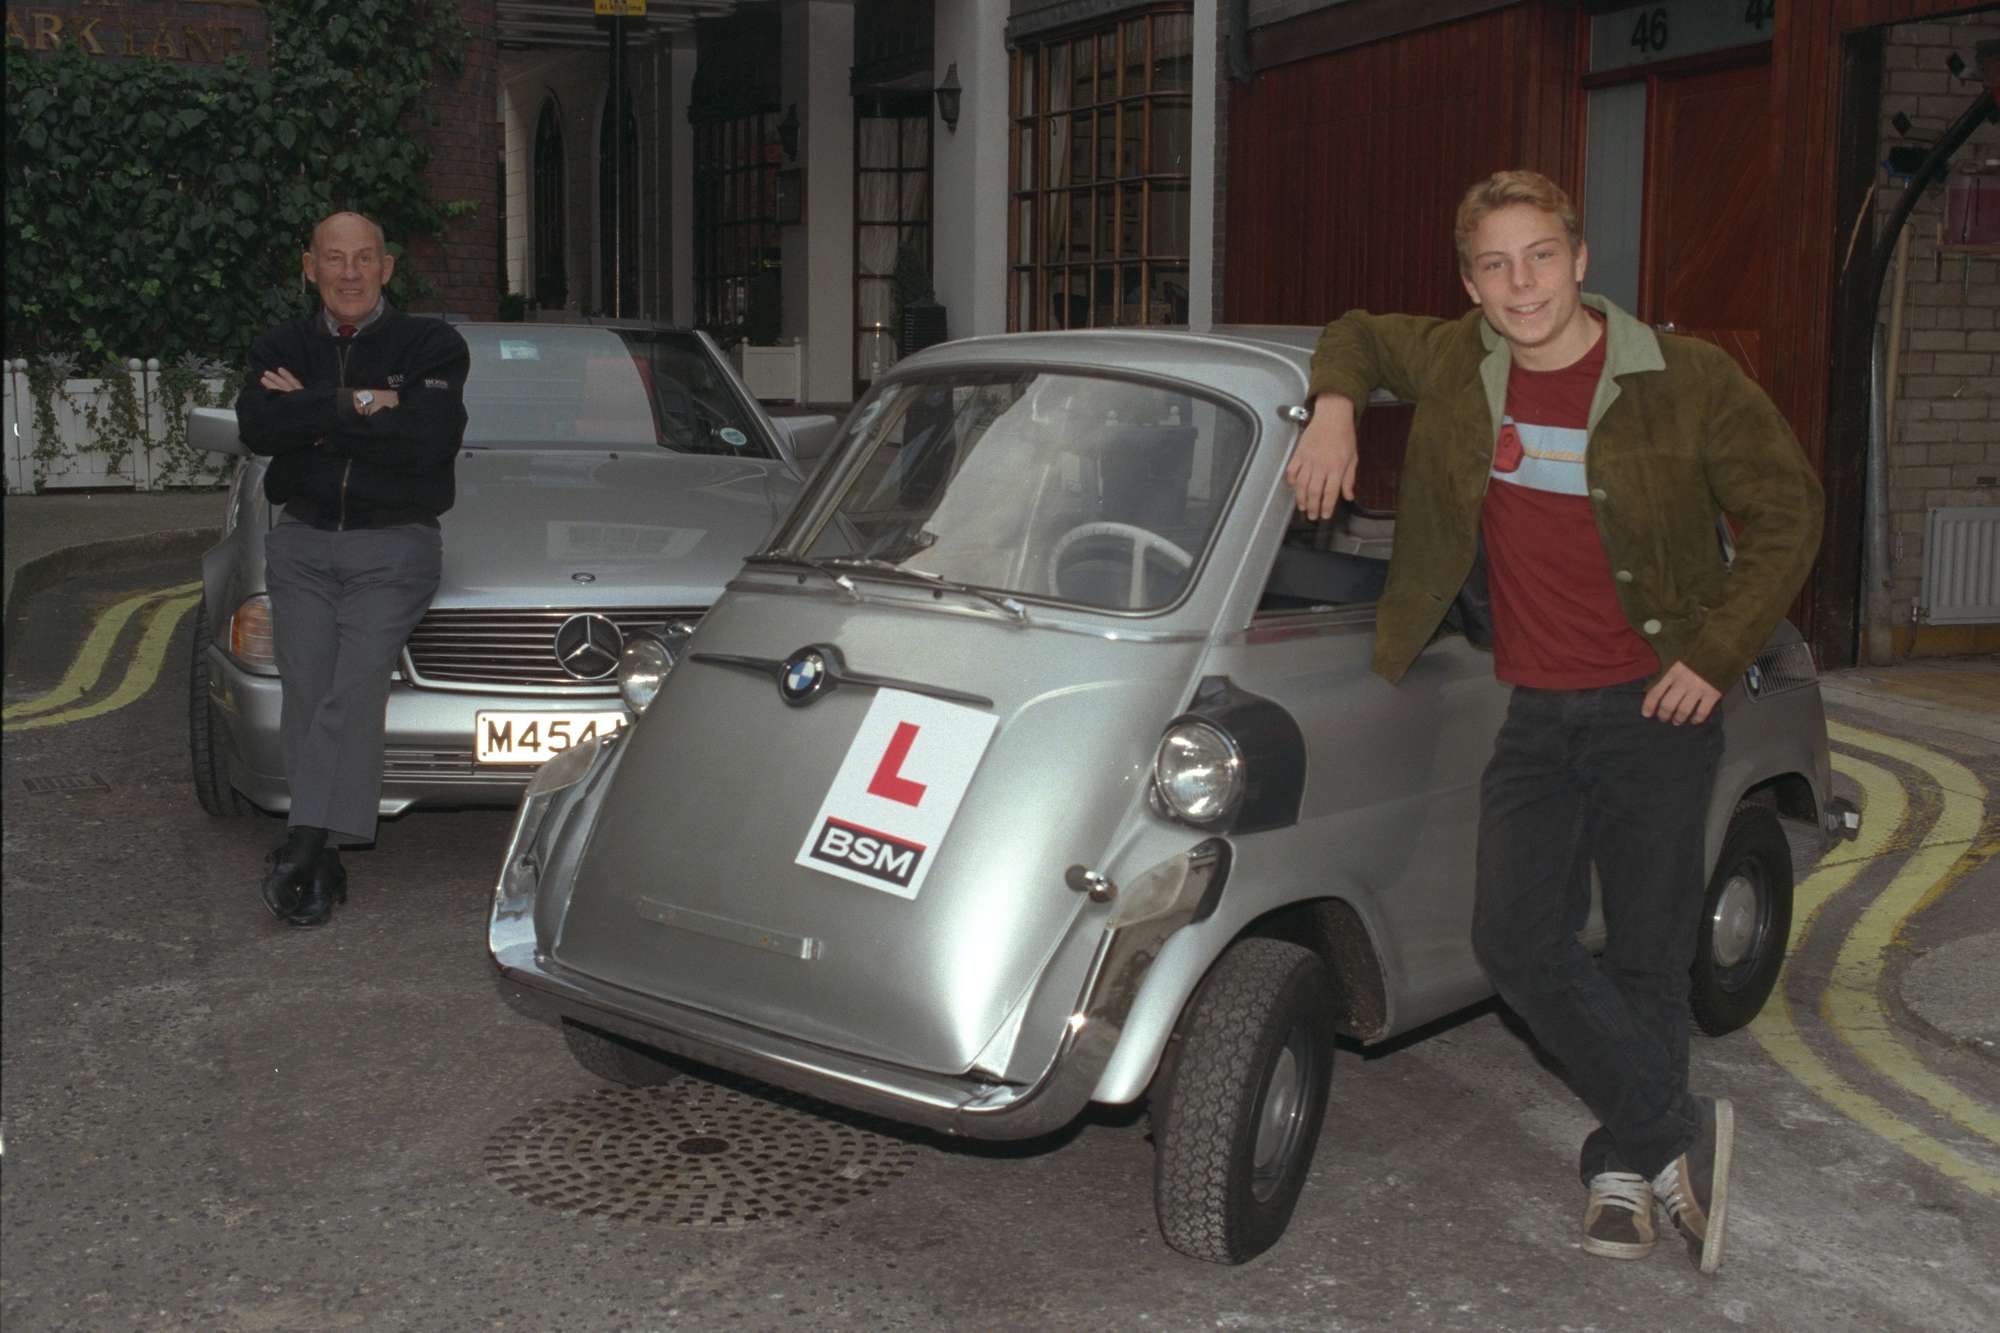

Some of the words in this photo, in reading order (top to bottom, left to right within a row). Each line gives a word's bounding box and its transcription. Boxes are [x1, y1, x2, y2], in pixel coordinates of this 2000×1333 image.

[1632, 8, 1667, 51] 46
[866, 720, 928, 808] L
[820, 827, 915, 878] BSM
